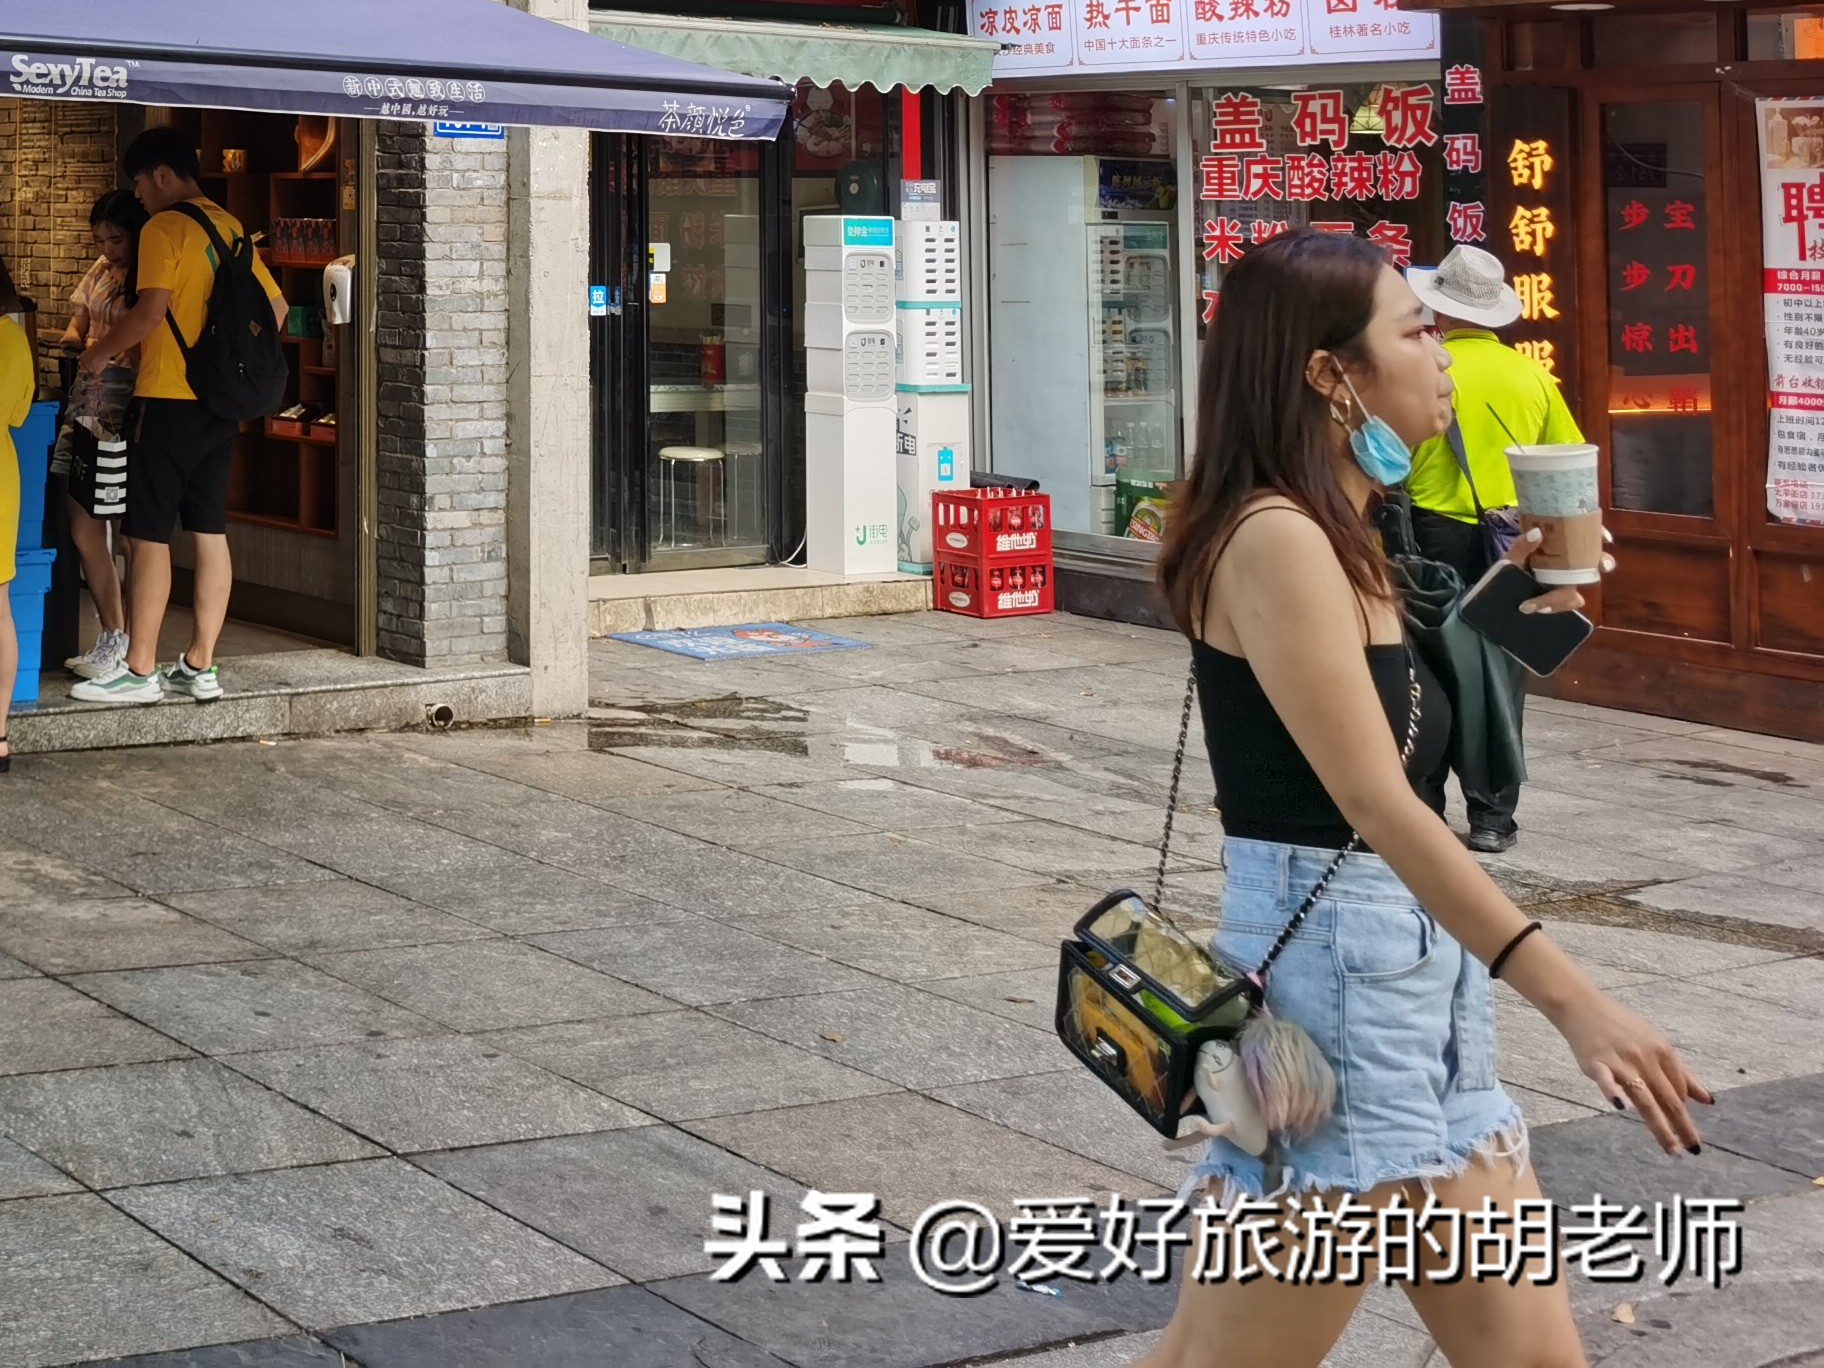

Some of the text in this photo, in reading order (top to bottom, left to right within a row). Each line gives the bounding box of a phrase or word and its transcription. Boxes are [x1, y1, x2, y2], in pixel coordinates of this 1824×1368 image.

[979, 3, 1064, 37] 凉皮凉面
[1328, 21, 1411, 39] 桂林著名小吃
[1084, 32, 1177, 52] 中国十大面条之一
[1195, 28, 1297, 46] 重庆传统特色小吃
[10, 54, 128, 93] SexyTea
[22, 84, 126, 99] Modern China Tea Shop
[342, 75, 486, 103] 新中式趣致生活
[1211, 84, 1438, 153] 盖码饭
[1443, 64, 1487, 243] 盖码饭
[1200, 150, 1423, 201] 重庆酸辣粉
[592, 289, 605, 304] 拉
[1619, 199, 1653, 411] 步步惊心
[1778, 395, 1824, 406] 月薪4000
